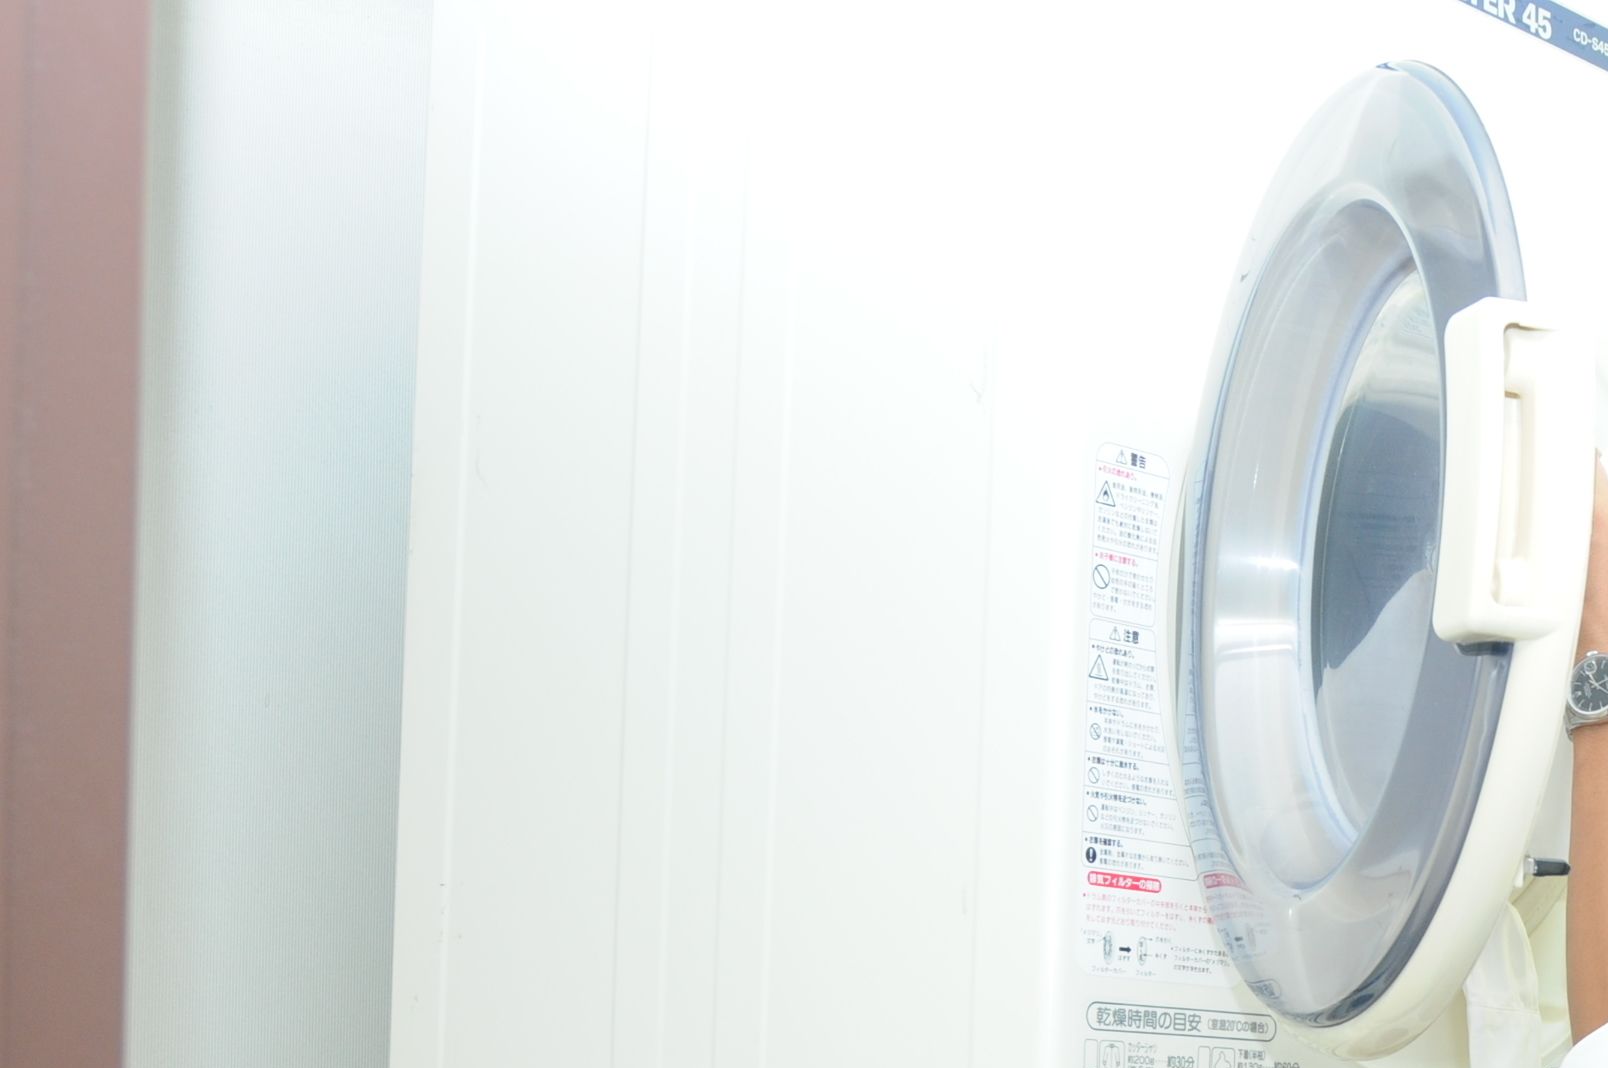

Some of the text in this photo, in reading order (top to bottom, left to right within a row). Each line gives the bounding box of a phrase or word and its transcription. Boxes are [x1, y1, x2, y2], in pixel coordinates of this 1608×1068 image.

[1471, 0, 1517, 24] ER
[1522, 3, 1552, 40] 45
[1097, 1008, 1202, 1033] 乾燥時間の目安
[1167, 1056, 1195, 1068] 約30分
